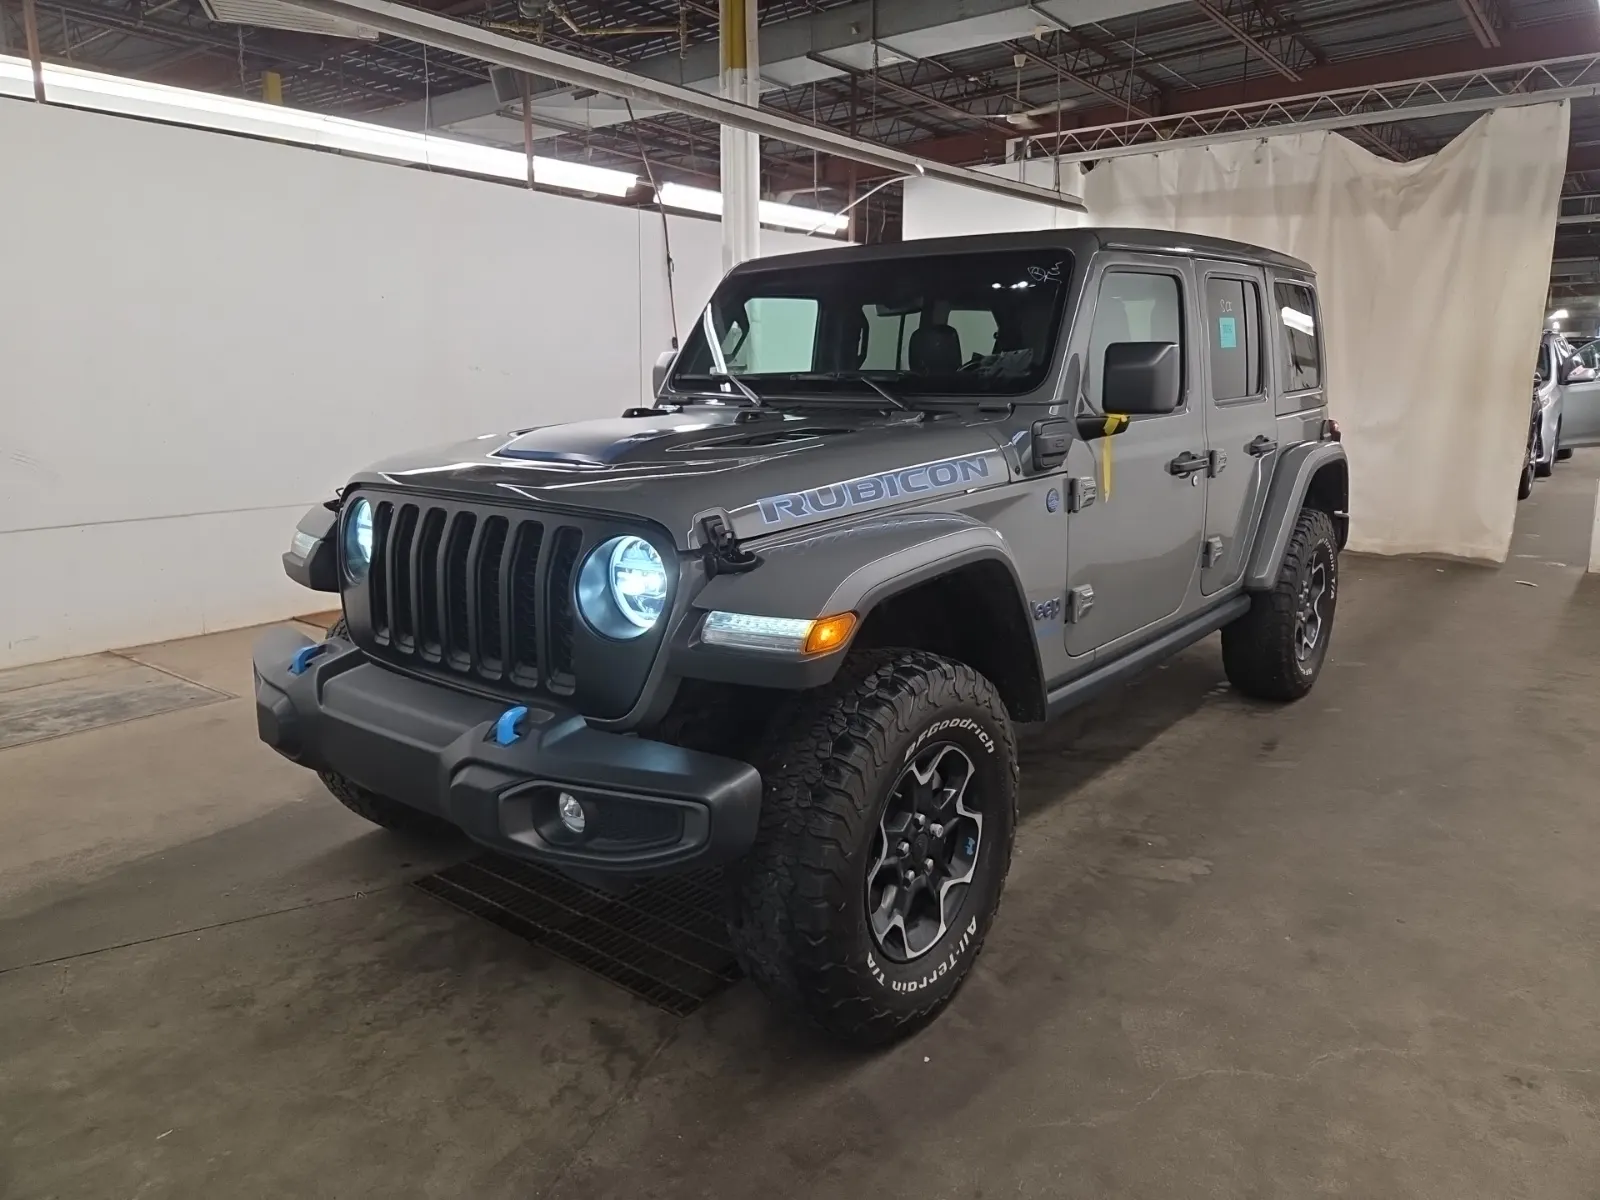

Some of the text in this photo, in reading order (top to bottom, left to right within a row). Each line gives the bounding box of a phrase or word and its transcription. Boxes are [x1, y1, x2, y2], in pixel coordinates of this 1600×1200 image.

[757, 456, 990, 525] RUBICON
[1030, 597, 1060, 620] Jeep
[903, 718, 995, 763] BFGoodrich
[866, 914, 978, 995] All-Terrain T/A
